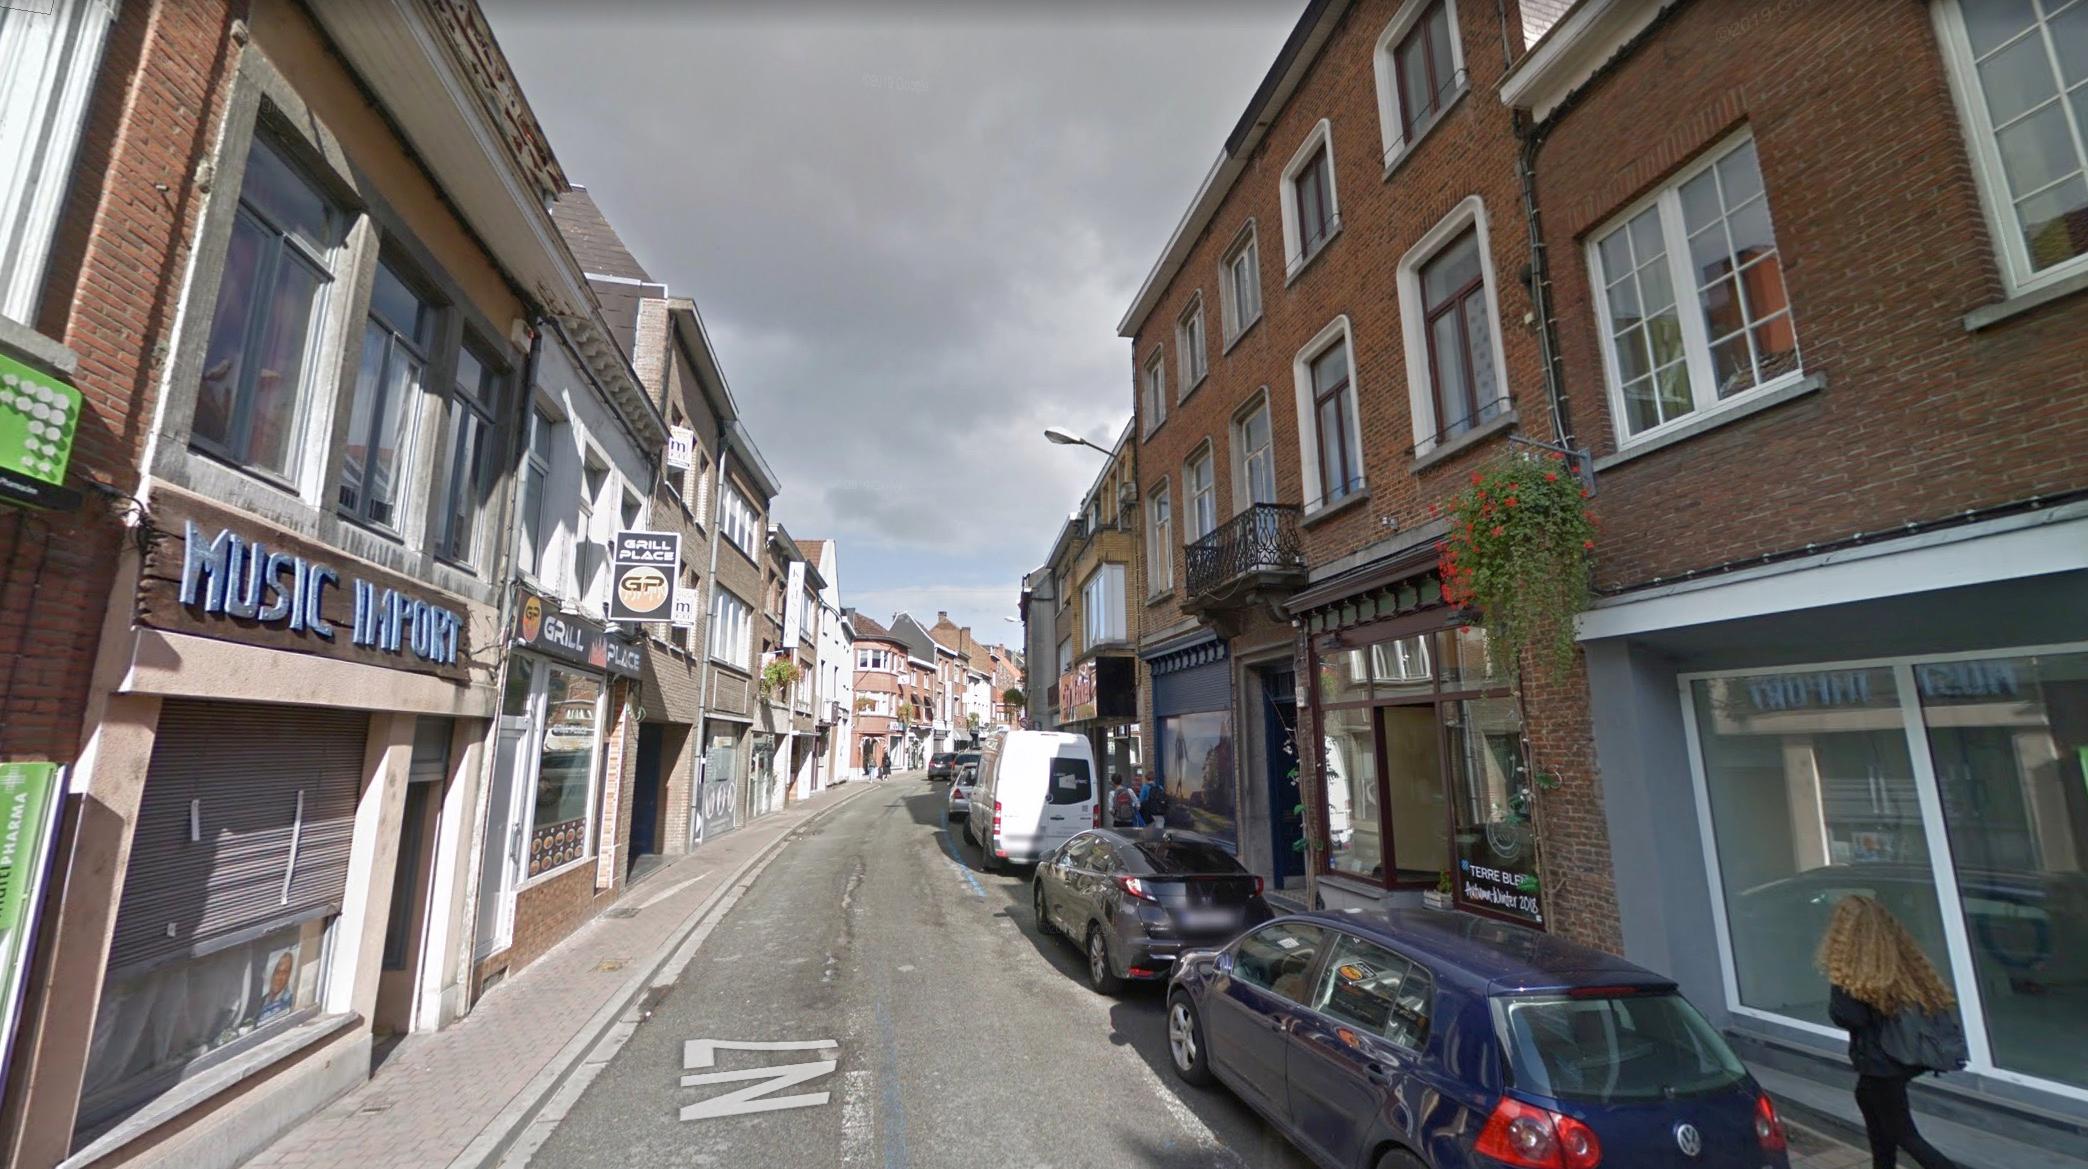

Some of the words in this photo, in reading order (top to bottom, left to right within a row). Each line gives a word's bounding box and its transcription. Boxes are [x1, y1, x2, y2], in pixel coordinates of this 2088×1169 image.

[623, 539, 671, 550] GRILL
[619, 550, 675, 561] PLACE
[179, 519, 341, 638] MUSIC
[351, 578, 464, 664] IMPORT
[621, 575, 665, 592] GP
[543, 615, 584, 652] GRILL
[607, 643, 641, 671] PLACE
[1470, 865, 1501, 882] TERRE
[1519, 896, 1539, 914] 2018
